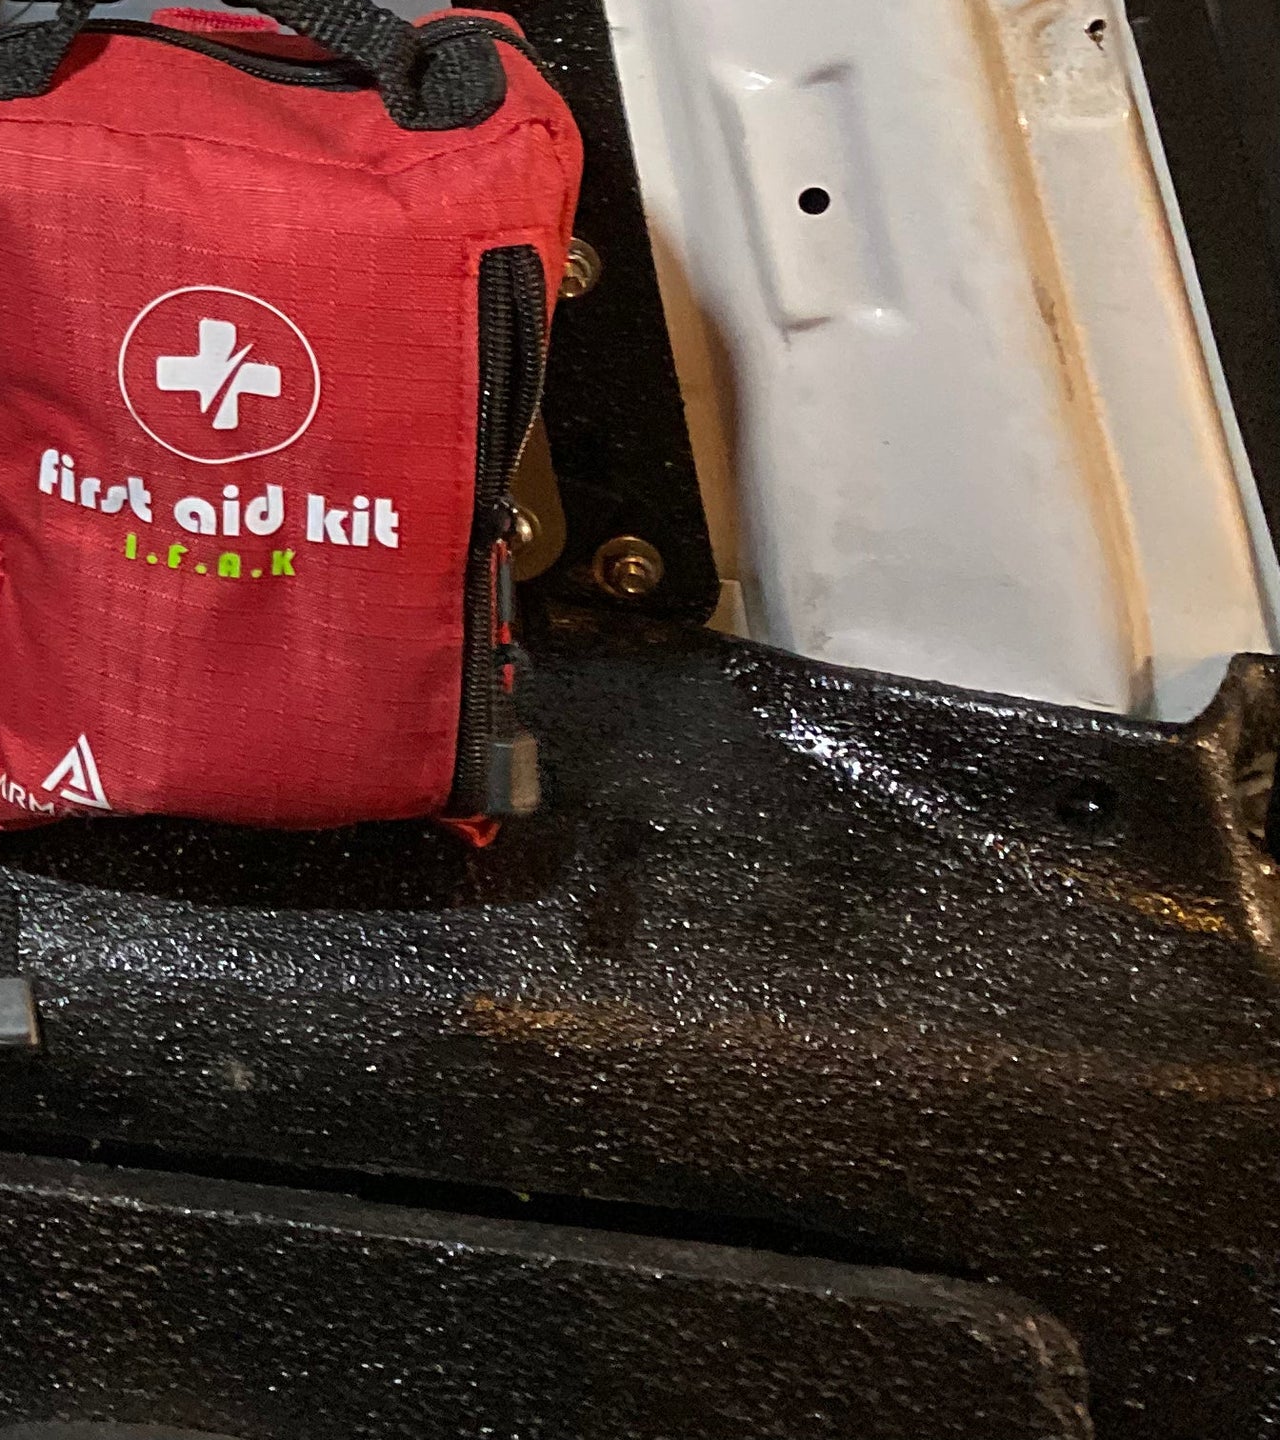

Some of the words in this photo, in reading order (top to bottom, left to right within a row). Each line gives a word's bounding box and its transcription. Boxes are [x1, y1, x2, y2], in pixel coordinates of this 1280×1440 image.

[39, 448, 152, 523] first
[173, 485, 284, 537] aid
[306, 493, 400, 548] kit
